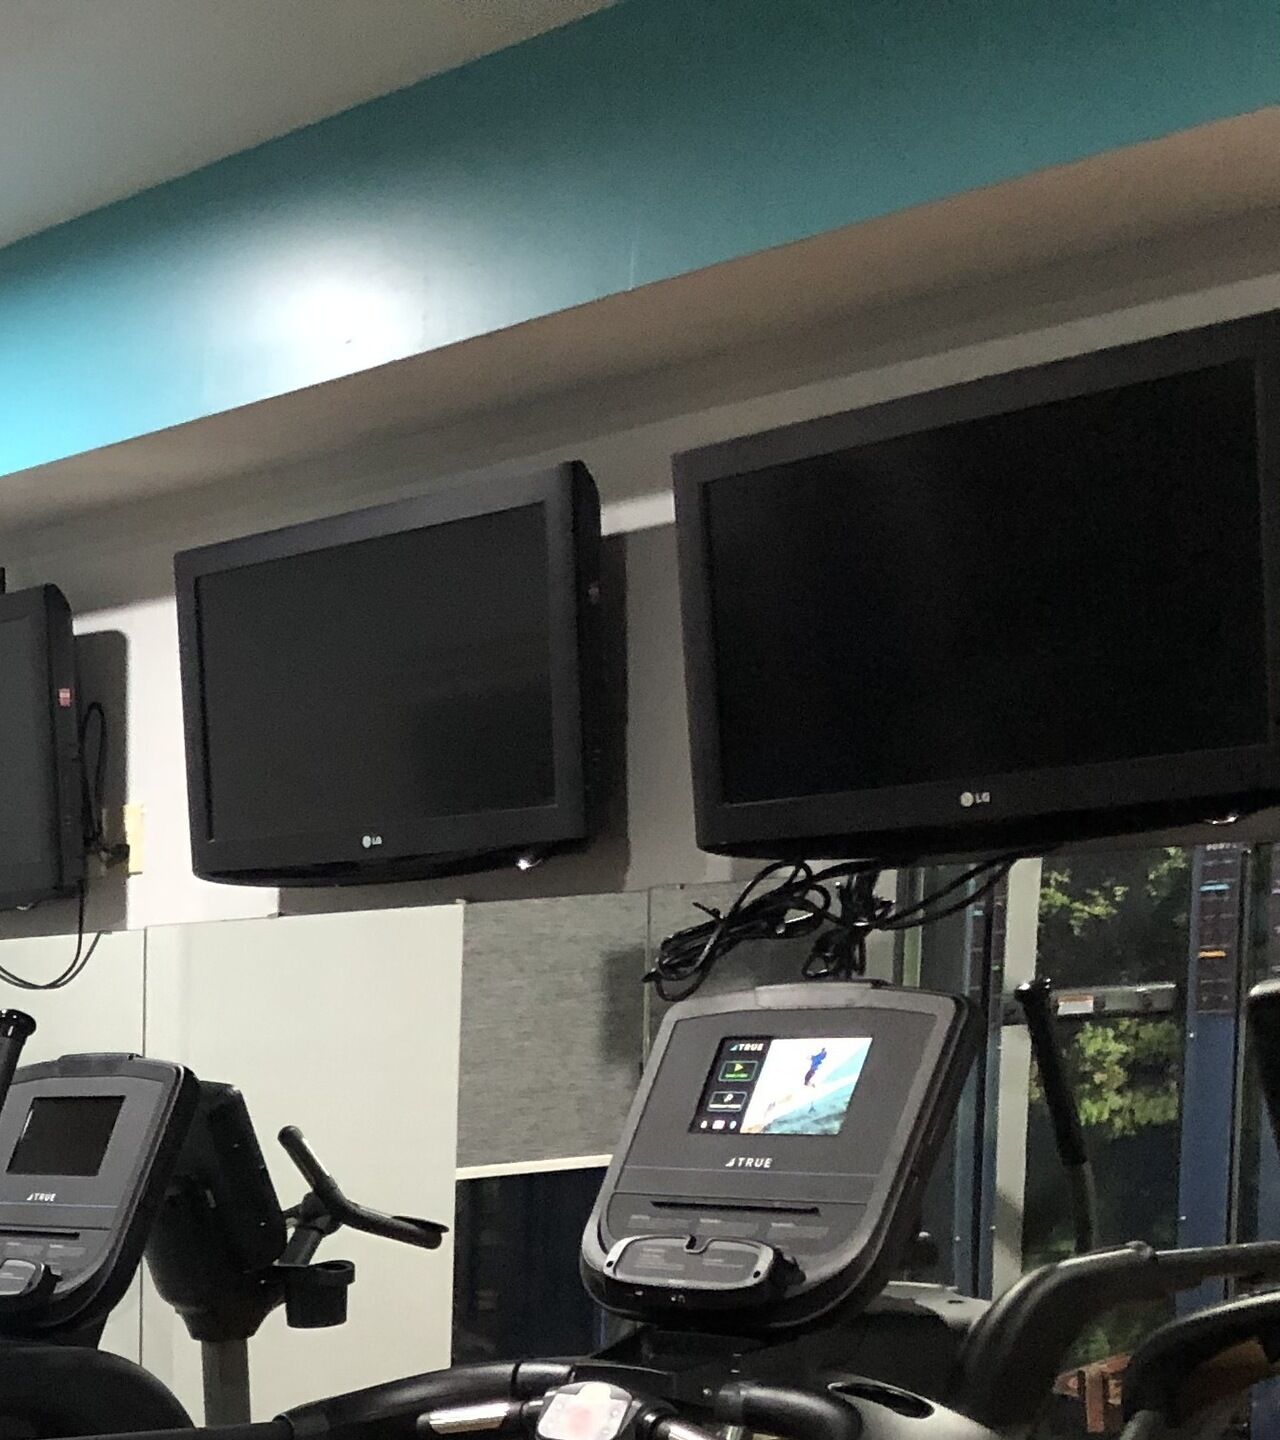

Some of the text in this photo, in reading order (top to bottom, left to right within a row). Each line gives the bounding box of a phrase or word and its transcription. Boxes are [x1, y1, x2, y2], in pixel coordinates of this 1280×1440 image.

[738, 1043, 765, 1052] TRUE
[738, 1157, 773, 1169] TRUE
[34, 1192, 57, 1202] TRUE
